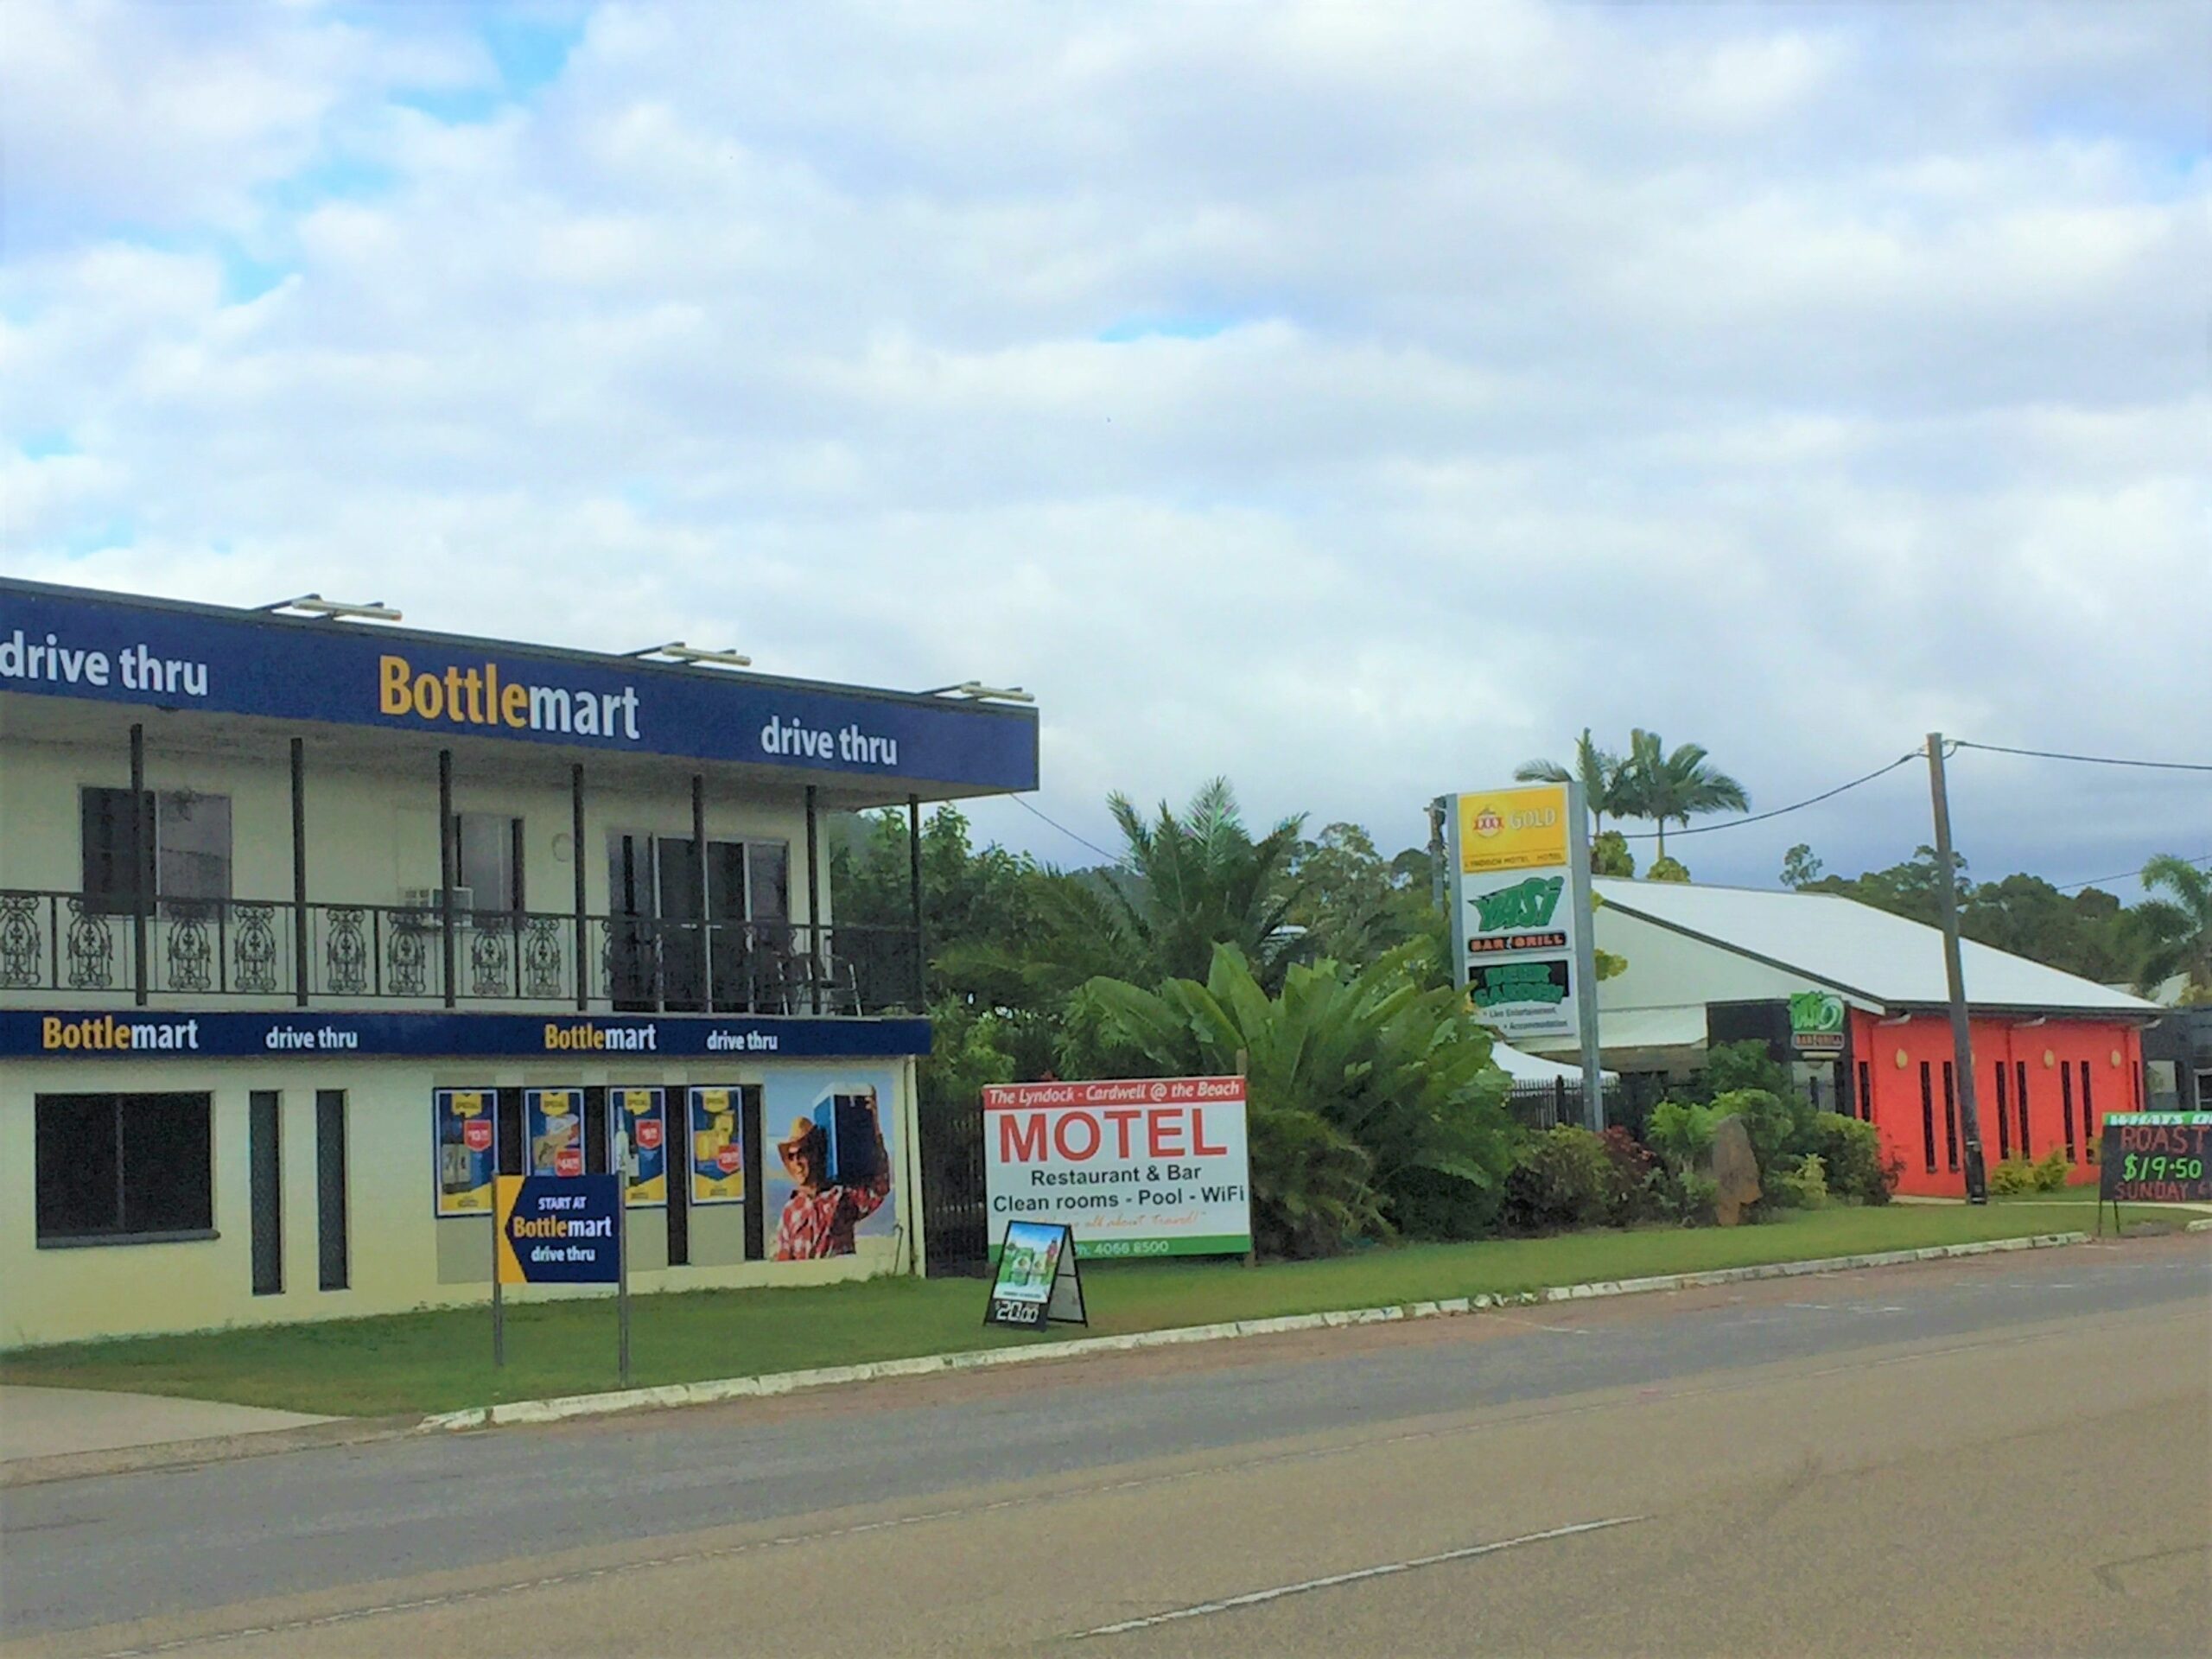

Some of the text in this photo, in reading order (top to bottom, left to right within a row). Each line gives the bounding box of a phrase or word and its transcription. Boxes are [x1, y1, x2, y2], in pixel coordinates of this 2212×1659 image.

[0, 630, 208, 696] drive thru
[379, 654, 640, 740] Bottlemart
[761, 715, 898, 766] drive thru
[1510, 808, 1555, 830] GOLD
[1471, 938, 1504, 951] BAR
[1514, 934, 1565, 949] GRILL
[43, 1015, 358, 1049] Bottlemart drive thru
[544, 1023, 778, 1050] Bottlemart drive thru
[989, 1089, 1015, 1105] The
[1085, 1084, 1146, 1102] Cardwell
[1150, 1083, 1167, 1102] @
[1171, 1084, 1193, 1098] the
[1198, 1080, 1239, 1097] Beach
[1000, 1109, 1228, 1163] MOTEL
[2120, 1126, 2210, 1154] ROAST
[1031, 1165, 1202, 1186] Restaurant & Bar
[2122, 1153, 2202, 1182] $19.50
[537, 1197, 587, 1211] START AT
[994, 1195, 1050, 1212] Clean
[1056, 1193, 1119, 1210] rooms
[1138, 1188, 1182, 1205] Pool
[1201, 1185, 1244, 1204] WiFi
[2113, 1181, 2189, 1201] SUNDAY
[512, 1215, 612, 1237] Bottlemart
[531, 1246, 596, 1262] drive thru
